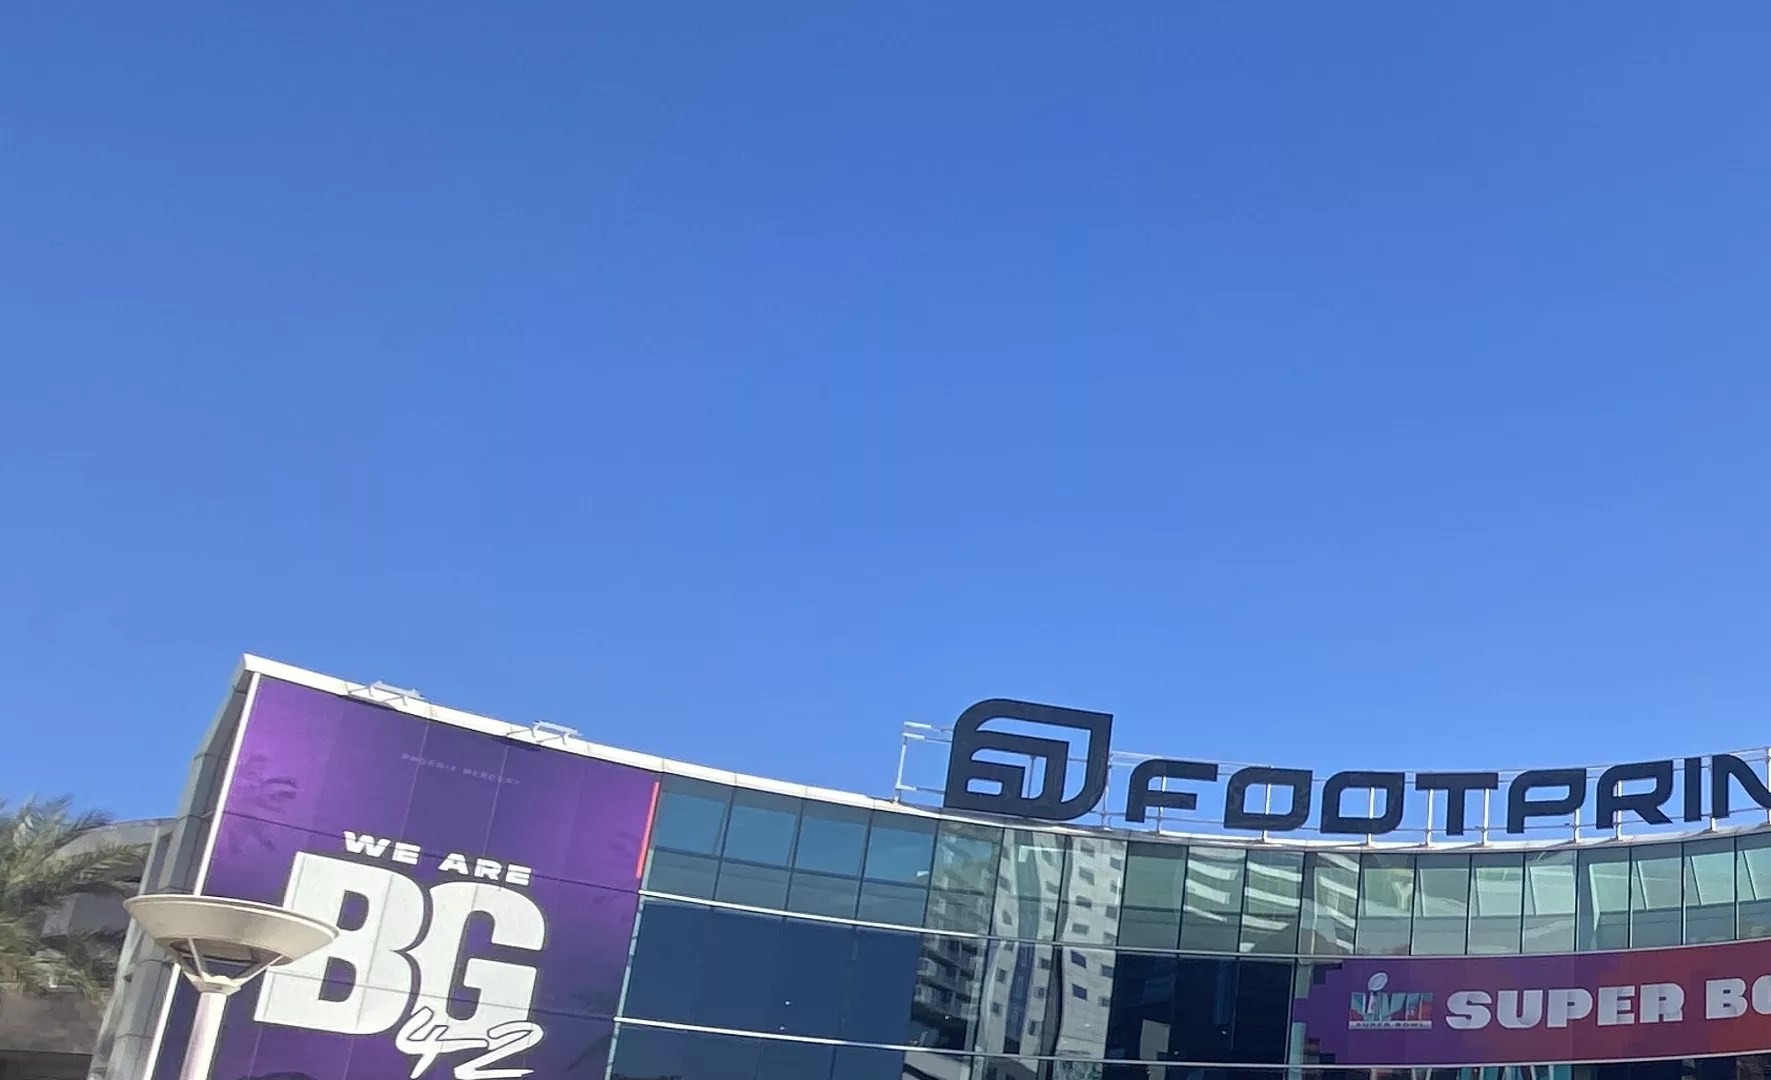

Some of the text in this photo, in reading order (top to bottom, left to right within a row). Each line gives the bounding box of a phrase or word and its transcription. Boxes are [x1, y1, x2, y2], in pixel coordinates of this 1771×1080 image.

[343, 831, 532, 886] WE ARE
[254, 851, 545, 1034] BG
[1446, 982, 1686, 1029] SUPER
[395, 1006, 544, 1080] 42
